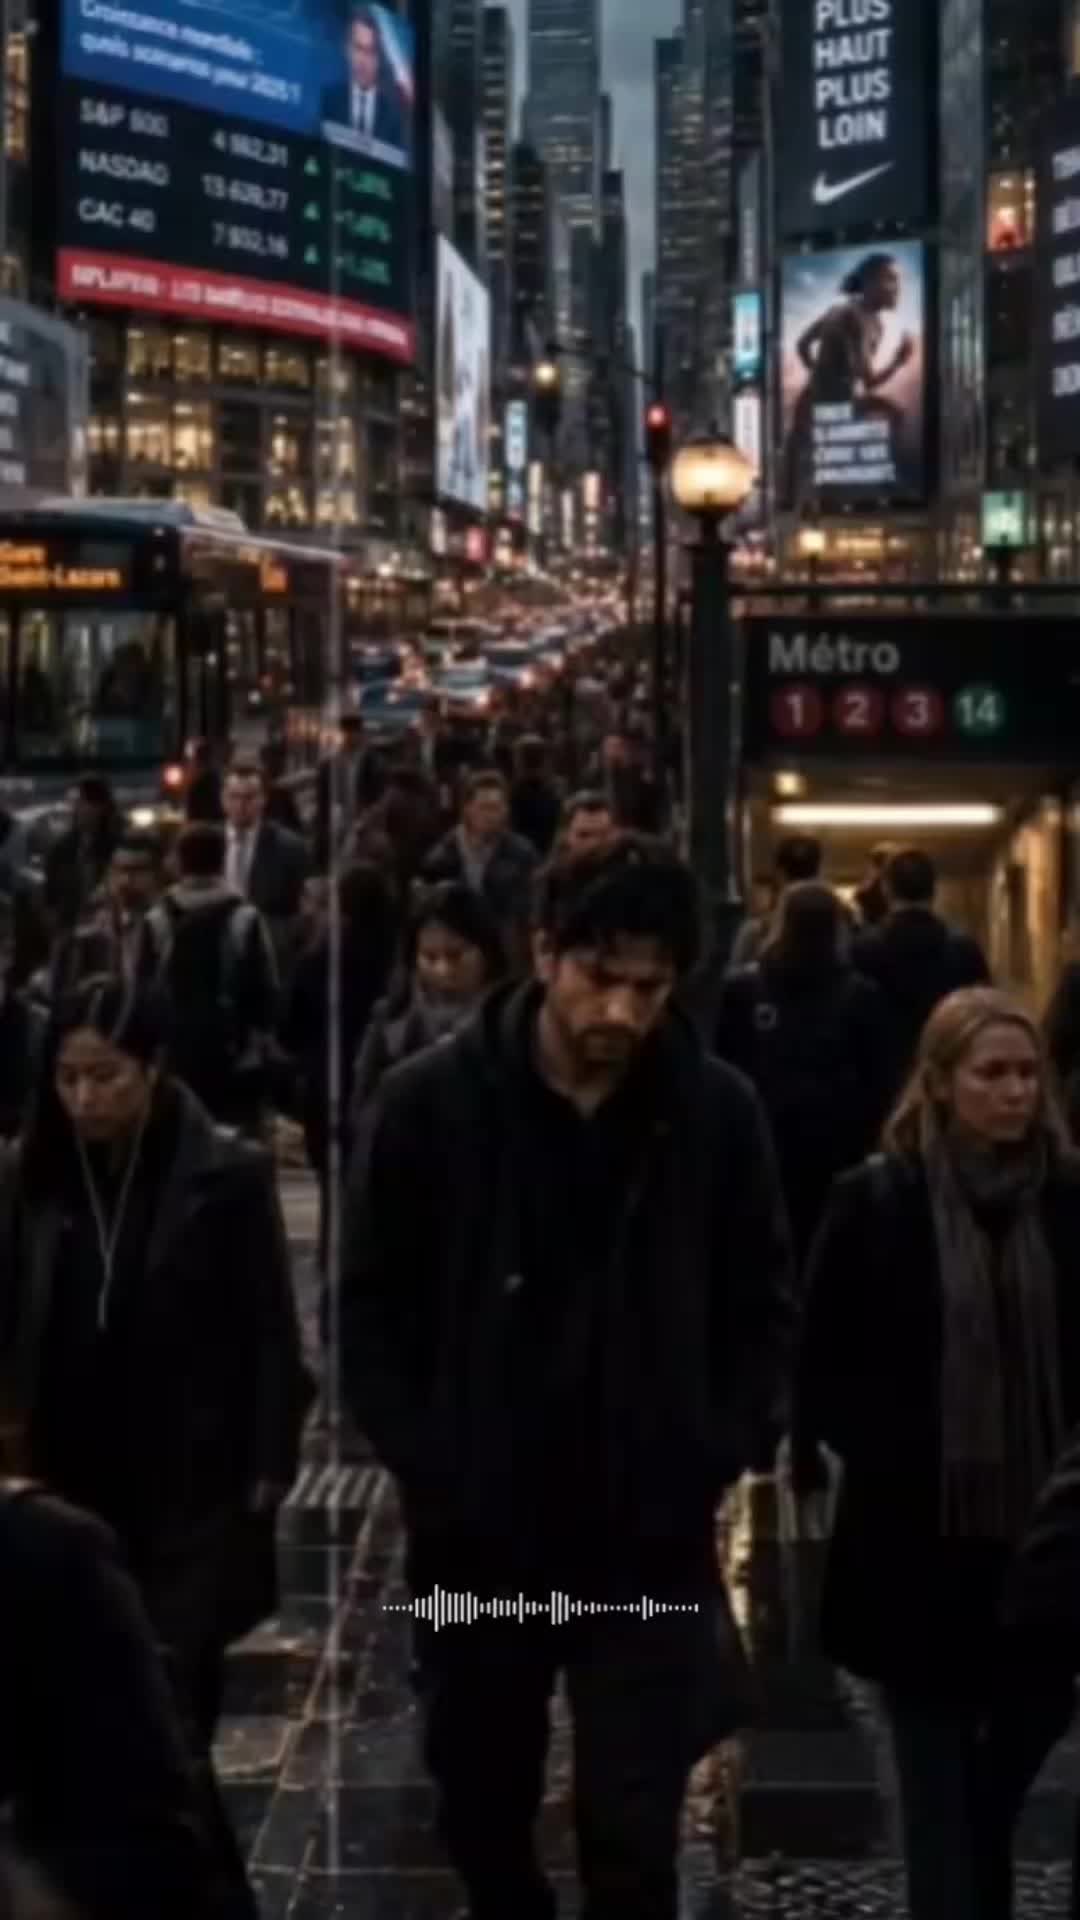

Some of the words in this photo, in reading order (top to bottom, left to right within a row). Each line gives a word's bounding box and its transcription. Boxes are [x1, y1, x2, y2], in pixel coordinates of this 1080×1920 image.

[815, 0, 890, 33] PLUS
[813, 28, 892, 70] HAUT
[815, 68, 891, 112] PLUS
[79, 97, 126, 129] S&P
[818, 110, 887, 148] LOIN
[78, 147, 170, 187] NASDAQ
[77, 196, 125, 228] CAC
[127, 207, 156, 234] 40
[768, 632, 901, 674] Métro
[785, 694, 805, 728] 1
[843, 694, 869, 728] 2
[903, 694, 930, 728] 3
[957, 693, 1000, 729] 14
